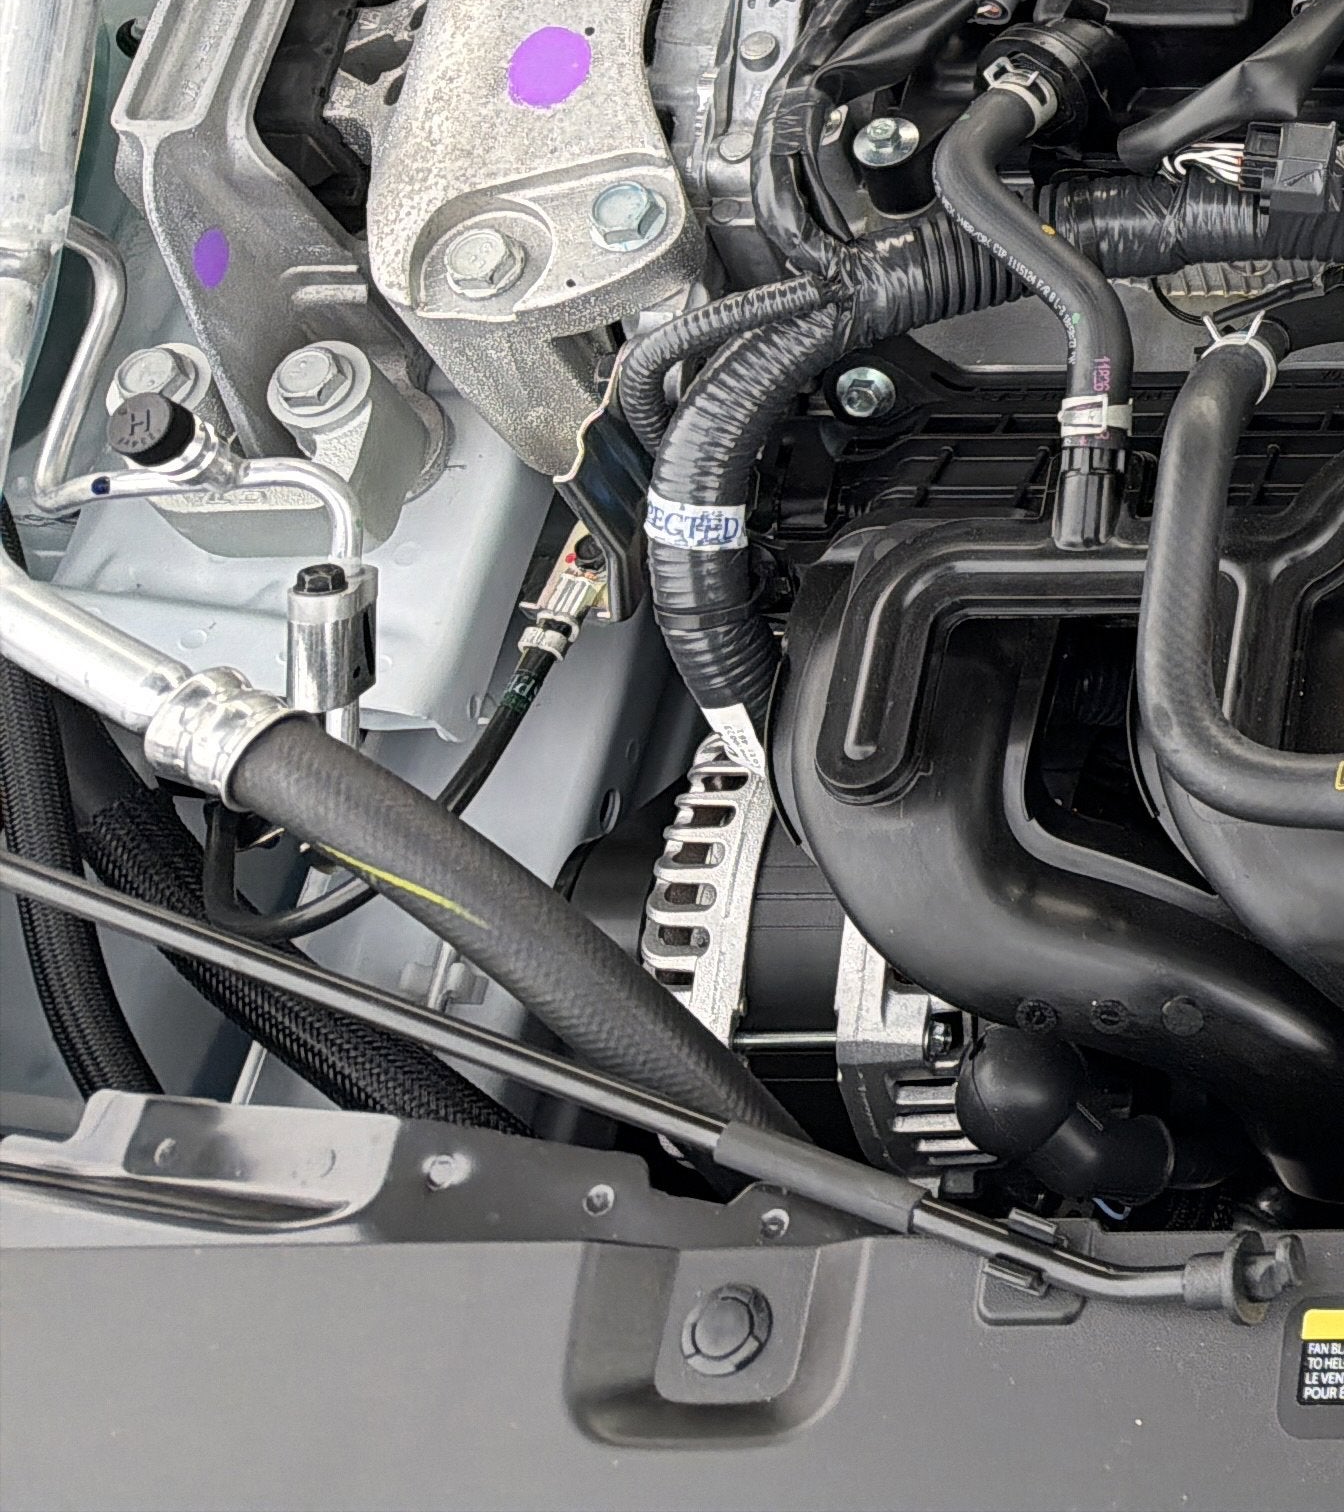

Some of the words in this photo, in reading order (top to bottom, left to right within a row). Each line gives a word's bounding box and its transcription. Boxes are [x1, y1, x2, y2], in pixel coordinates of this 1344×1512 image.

[125, 408, 153, 436] H
[1307, 1342, 1328, 1354] FAN
[1307, 1357, 1323, 1369] TO
[1304, 1372, 1319, 1384] LE
[1303, 1386, 1337, 1400] POUR
